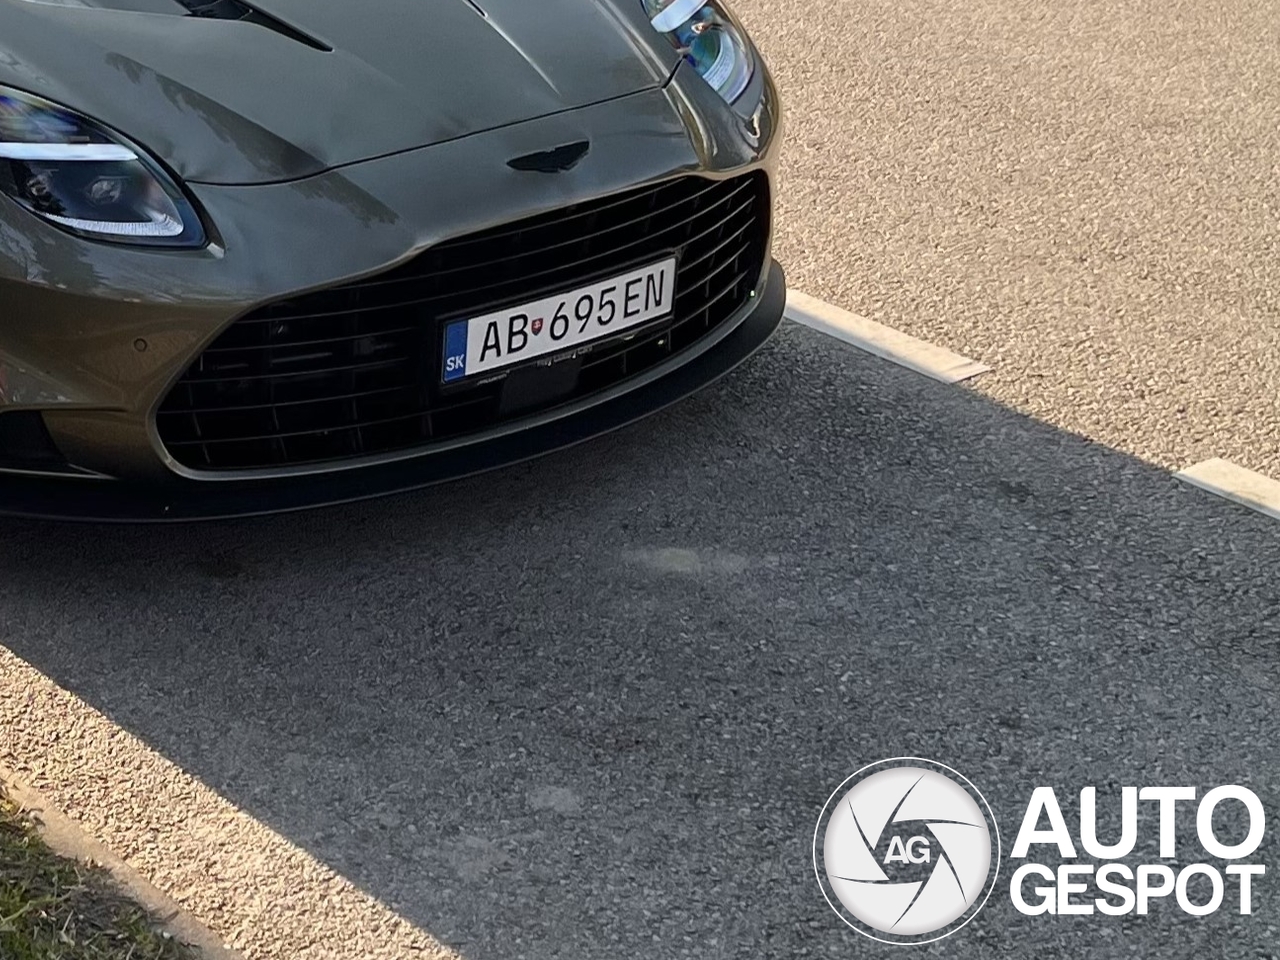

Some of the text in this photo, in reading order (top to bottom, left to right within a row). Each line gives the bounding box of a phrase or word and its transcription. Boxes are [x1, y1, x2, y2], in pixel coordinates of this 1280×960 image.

[479, 269, 665, 362] AB 695EN
[446, 354, 465, 371] SK
